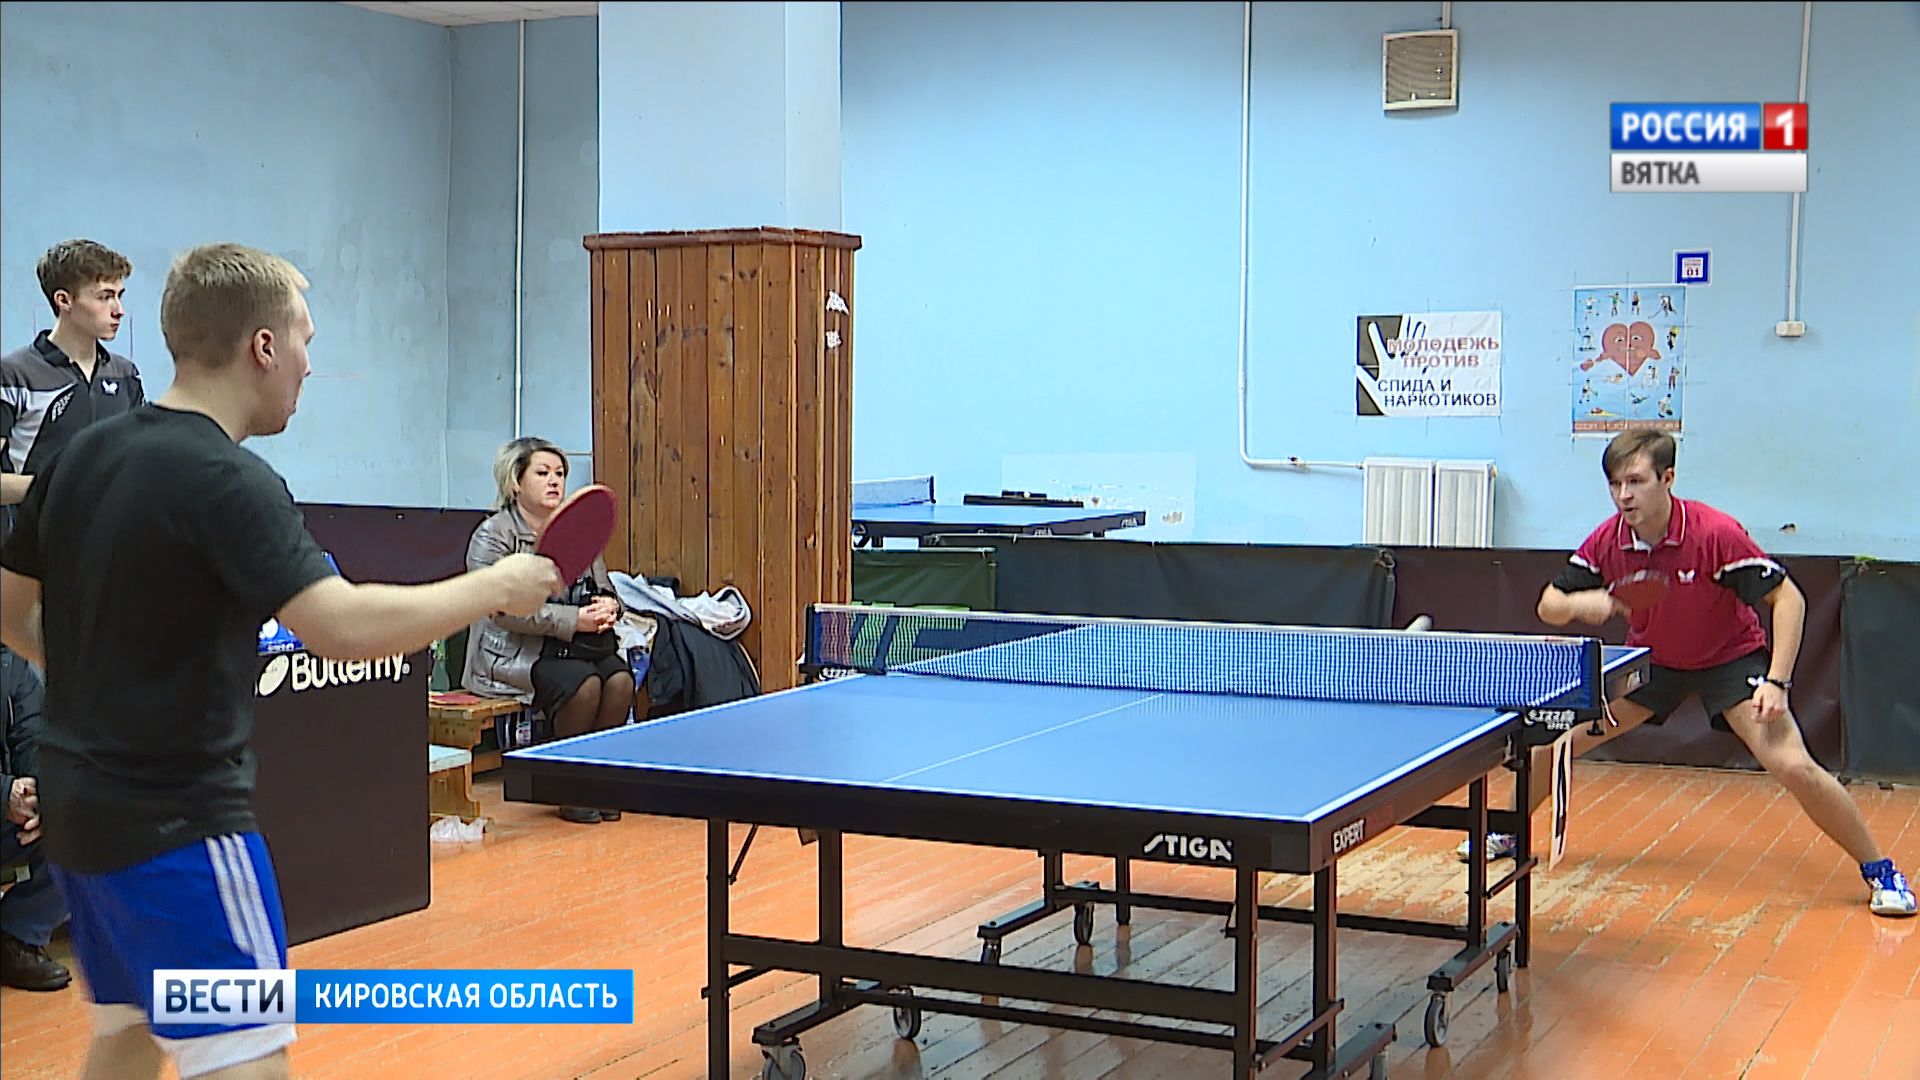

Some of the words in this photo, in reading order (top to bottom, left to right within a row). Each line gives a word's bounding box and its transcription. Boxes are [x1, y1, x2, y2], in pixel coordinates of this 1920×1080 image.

[1387, 337, 1499, 353] МОЛОДЕЖЬ
[1403, 355, 1480, 368] ПРОТИВ
[1377, 379, 1435, 393] СПИДА
[1440, 379, 1452, 392] И
[1384, 393, 1497, 408] НАРКОТИКОВ
[1333, 819, 1365, 854] EXPERT
[1143, 833, 1232, 862] STIGA
